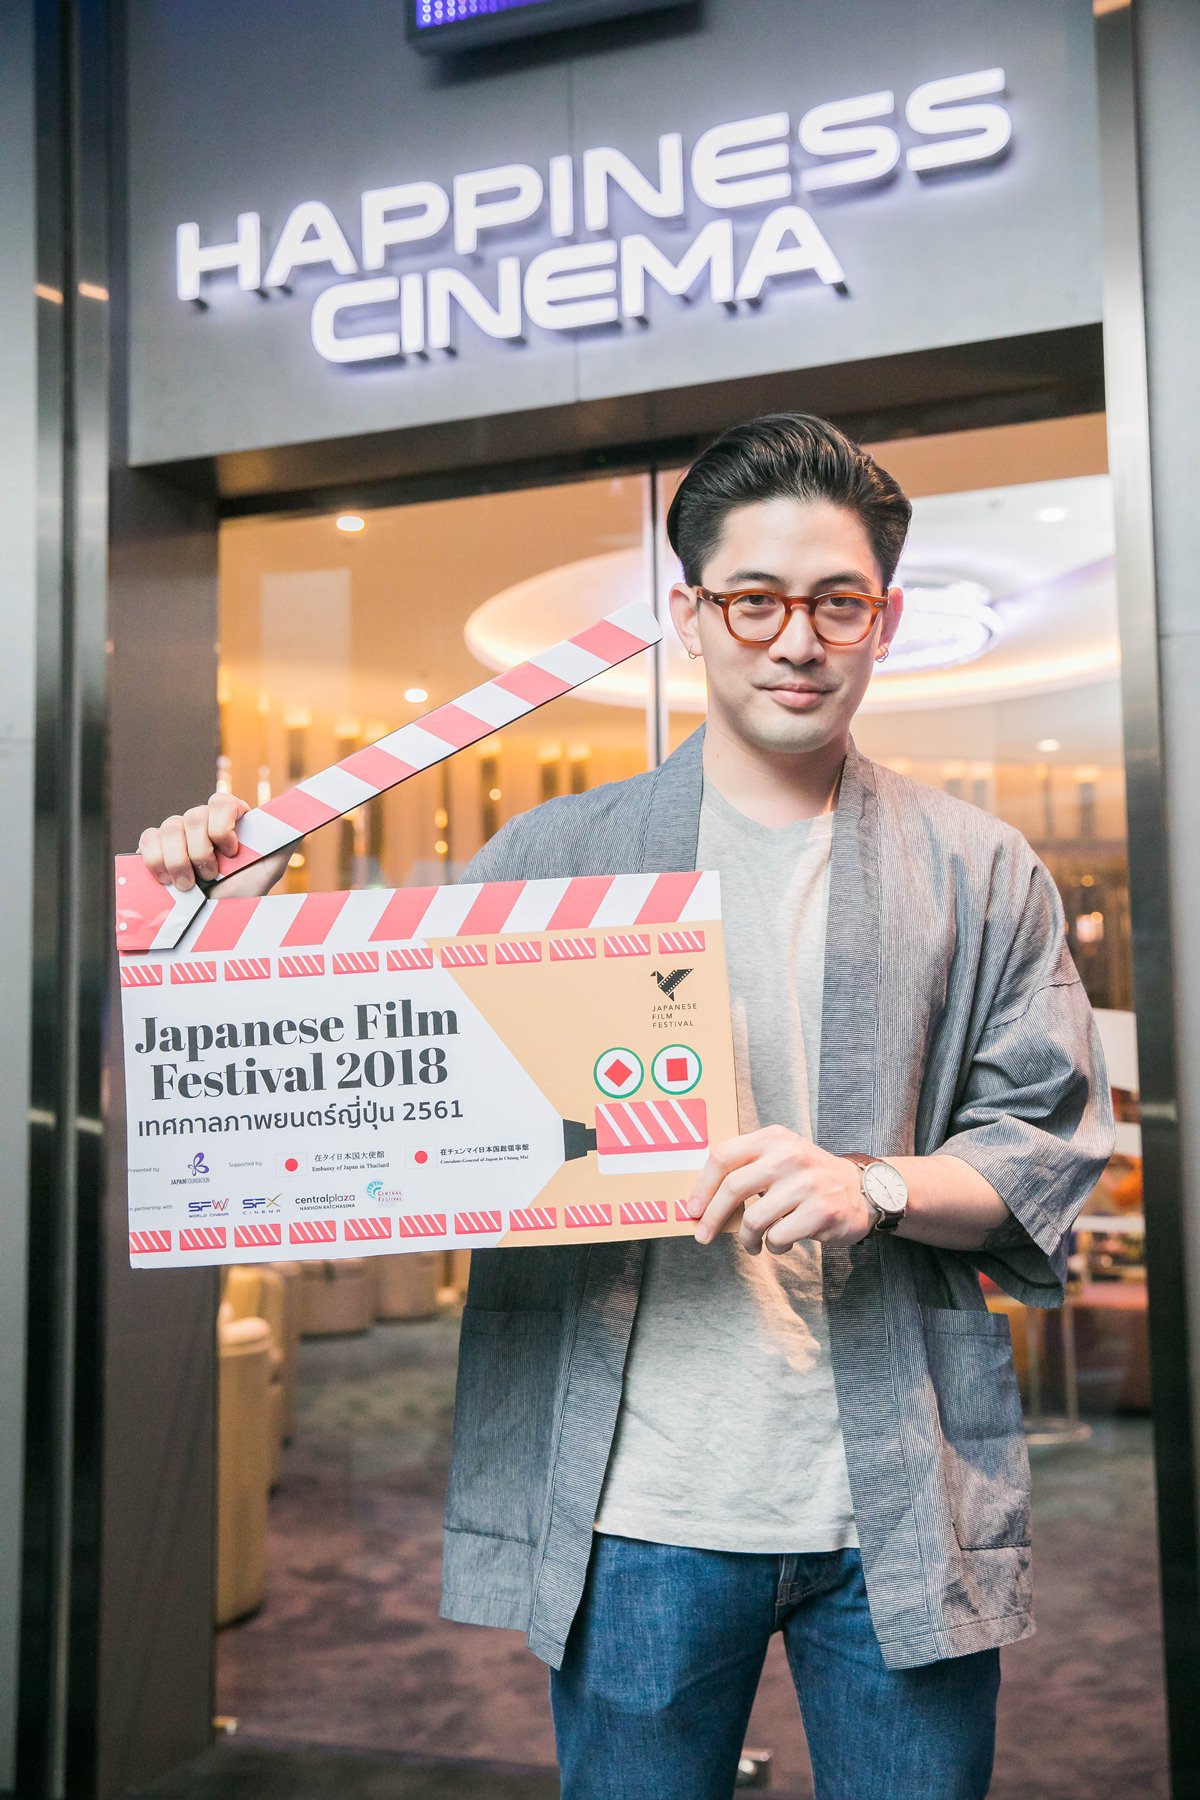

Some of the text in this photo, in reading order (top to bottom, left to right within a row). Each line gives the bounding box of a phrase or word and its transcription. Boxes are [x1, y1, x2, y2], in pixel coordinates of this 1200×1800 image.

[177, 68, 1012, 300] HAPPINESS
[310, 205, 846, 364] CINEMA
[651, 1002, 698, 1012] JAPANESE
[135, 999, 461, 1063] Japanese Film
[652, 1020, 694, 1029] FESTIVAL
[150, 1047, 449, 1101] Festival 2018
[138, 1095, 464, 1137] เทศกาลภาพยนตร์ญี่ปุ่น 2561
[313, 1150, 386, 1163] 在タイ日本国大使館
[439, 1143, 530, 1157] 在チェンマイ日本国総領事館
[311, 1165, 335, 1173] Embassy
[343, 1163, 359, 1172] Japan
[366, 1161, 390, 1169] Thailand
[188, 1197, 230, 1213] SFW
[242, 1192, 284, 1210] SFX
[294, 1193, 356, 1205] centralplaza
